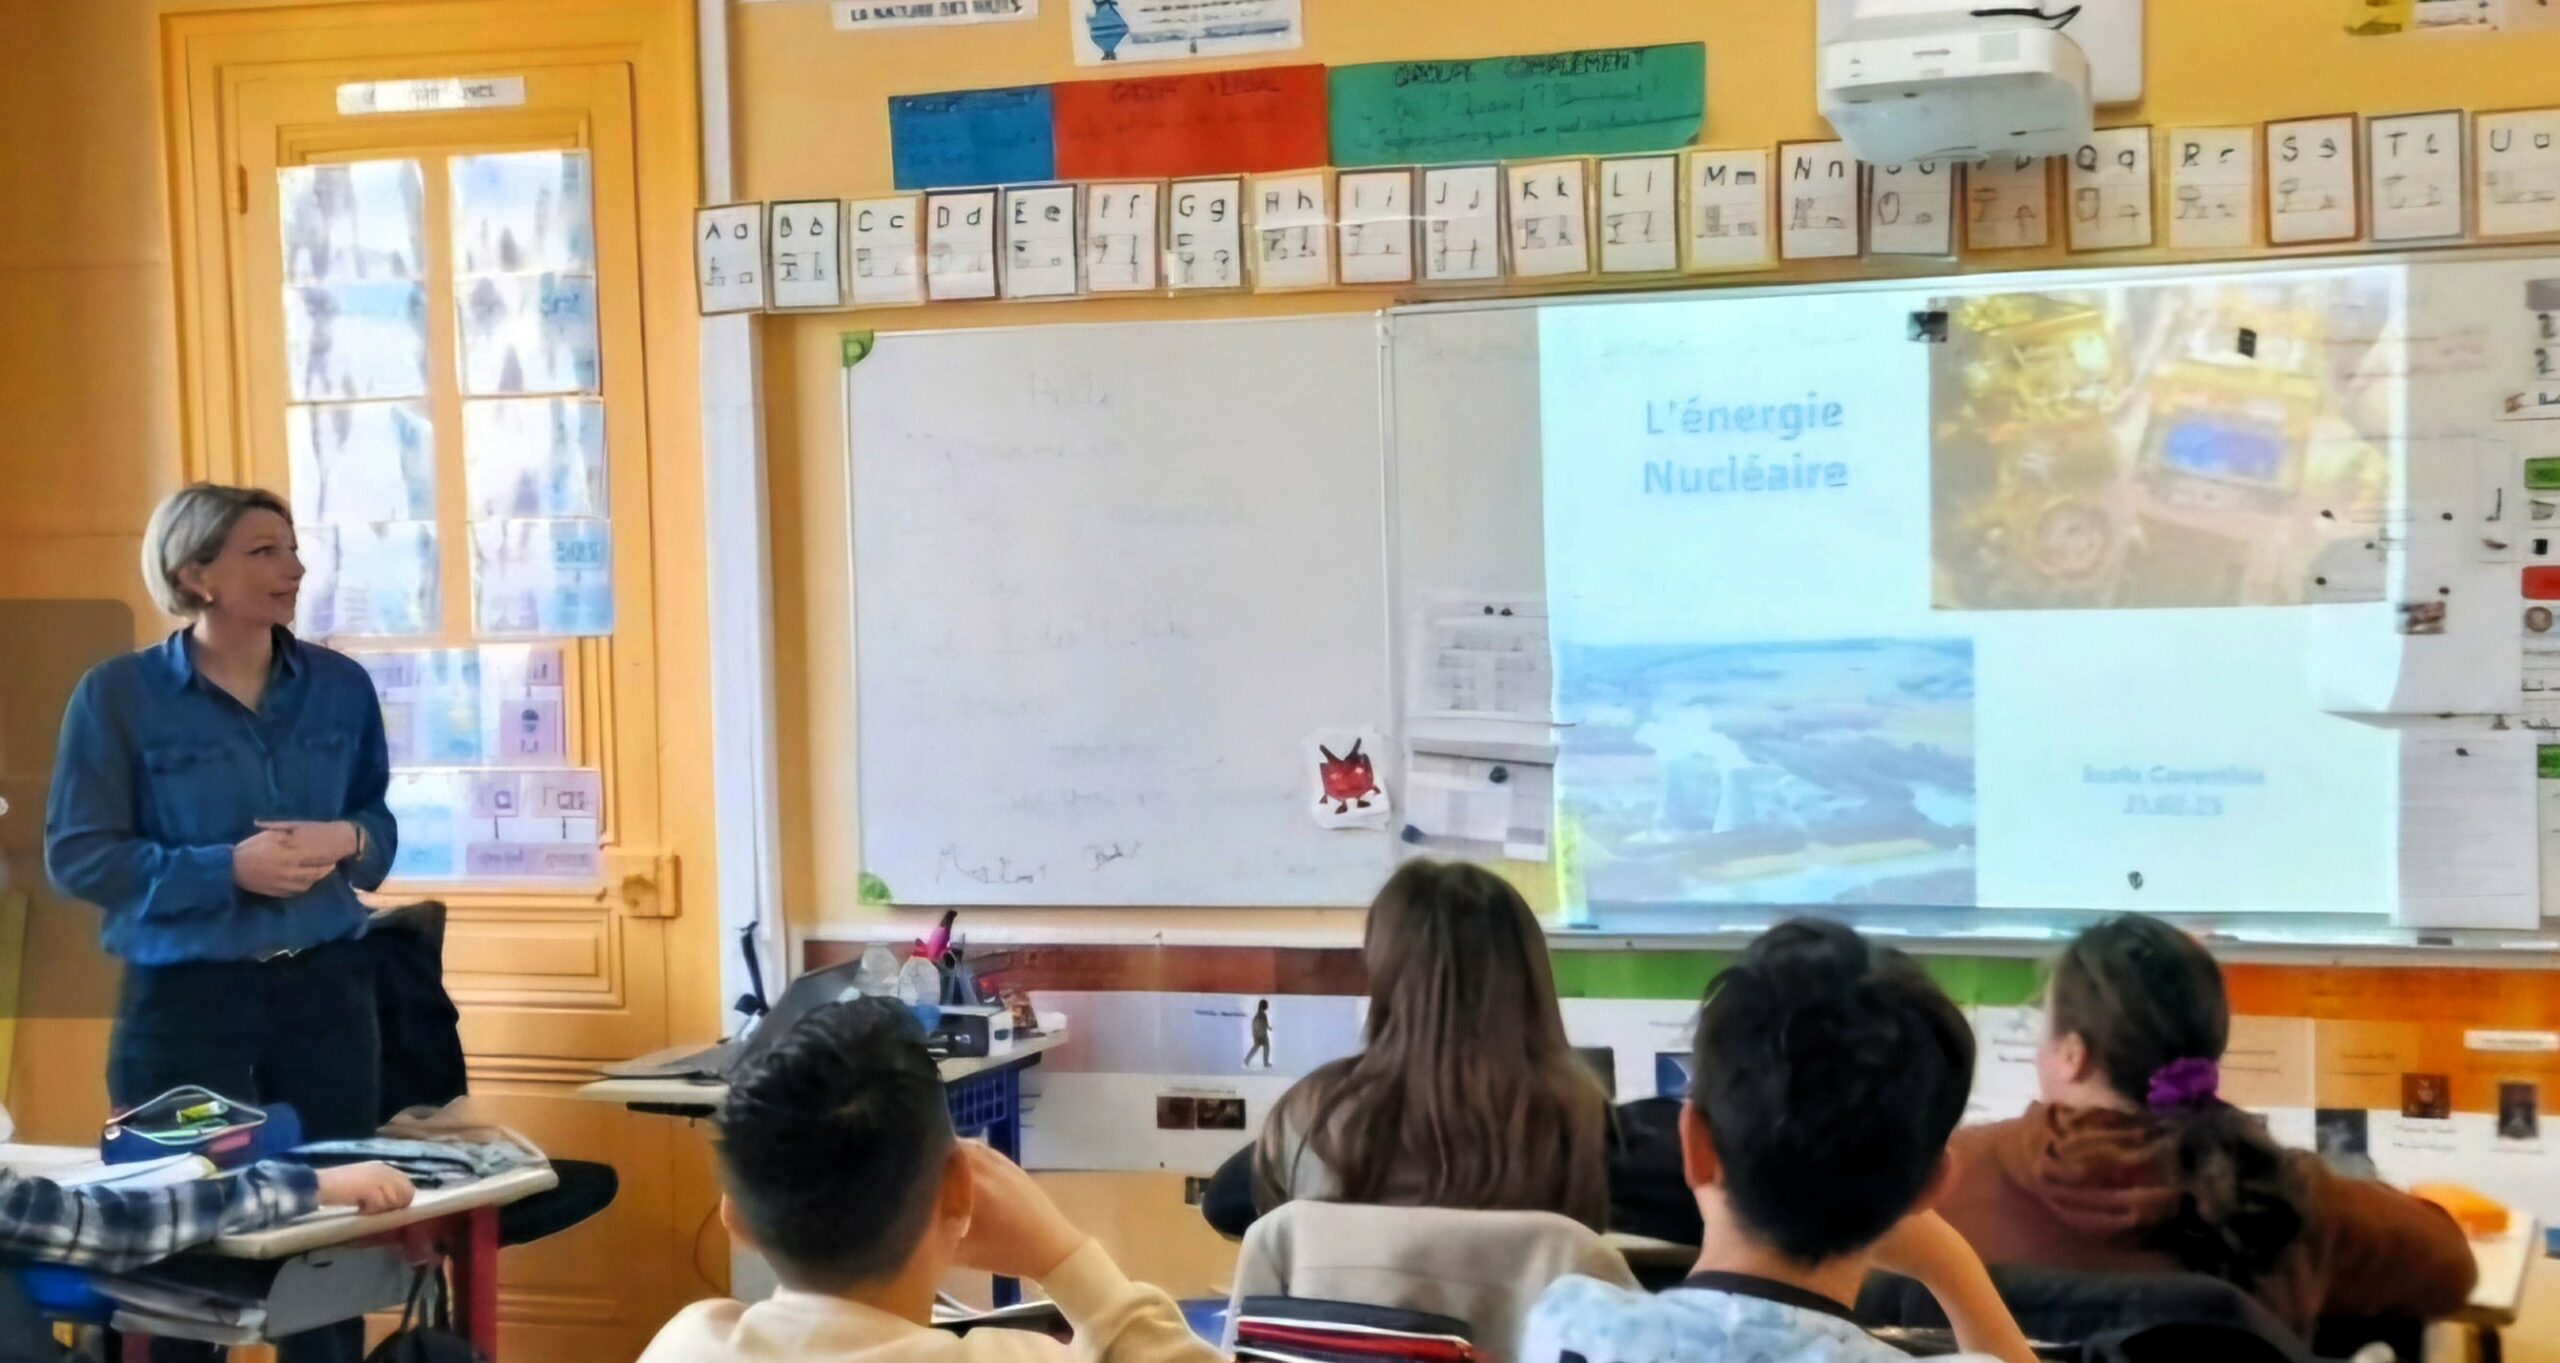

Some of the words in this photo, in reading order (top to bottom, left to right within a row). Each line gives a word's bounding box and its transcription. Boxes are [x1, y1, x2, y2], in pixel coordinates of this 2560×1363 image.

[937, 206, 950, 228] D
[1178, 194, 1195, 217] G
[859, 209, 873, 232] C
[1646, 391, 1844, 440] L'énergie
[1644, 453, 1848, 494] Nucléaire
